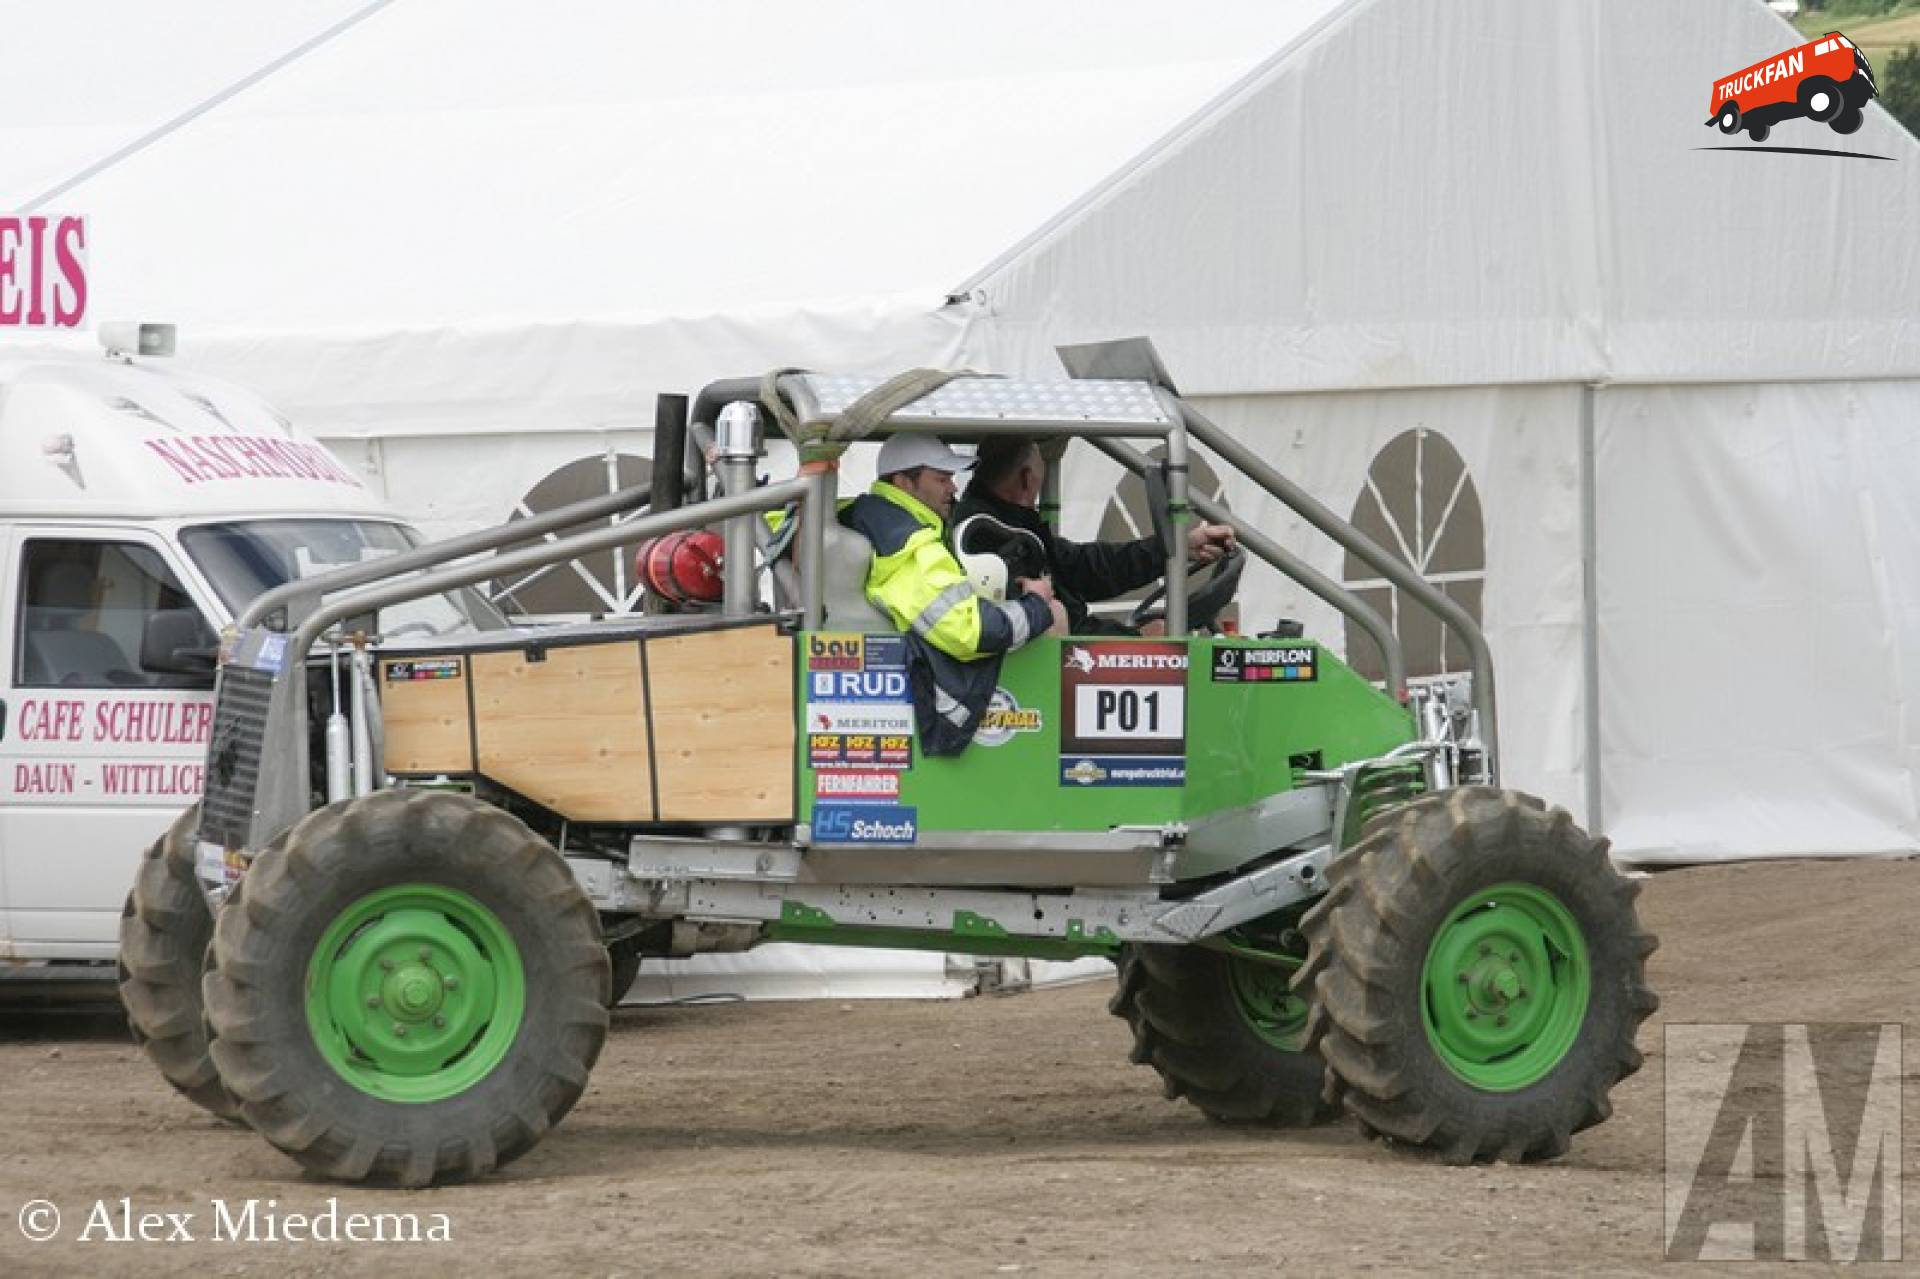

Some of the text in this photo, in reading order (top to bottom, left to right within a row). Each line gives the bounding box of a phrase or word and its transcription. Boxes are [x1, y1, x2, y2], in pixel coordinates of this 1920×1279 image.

[0, 216, 87, 328] EIS
[841, 673, 906, 696] RUD
[18, 700, 84, 743] CAFE
[837, 718, 908, 728] MERITOR
[14, 764, 75, 795] DAUN
[851, 819, 914, 840] Schoch
